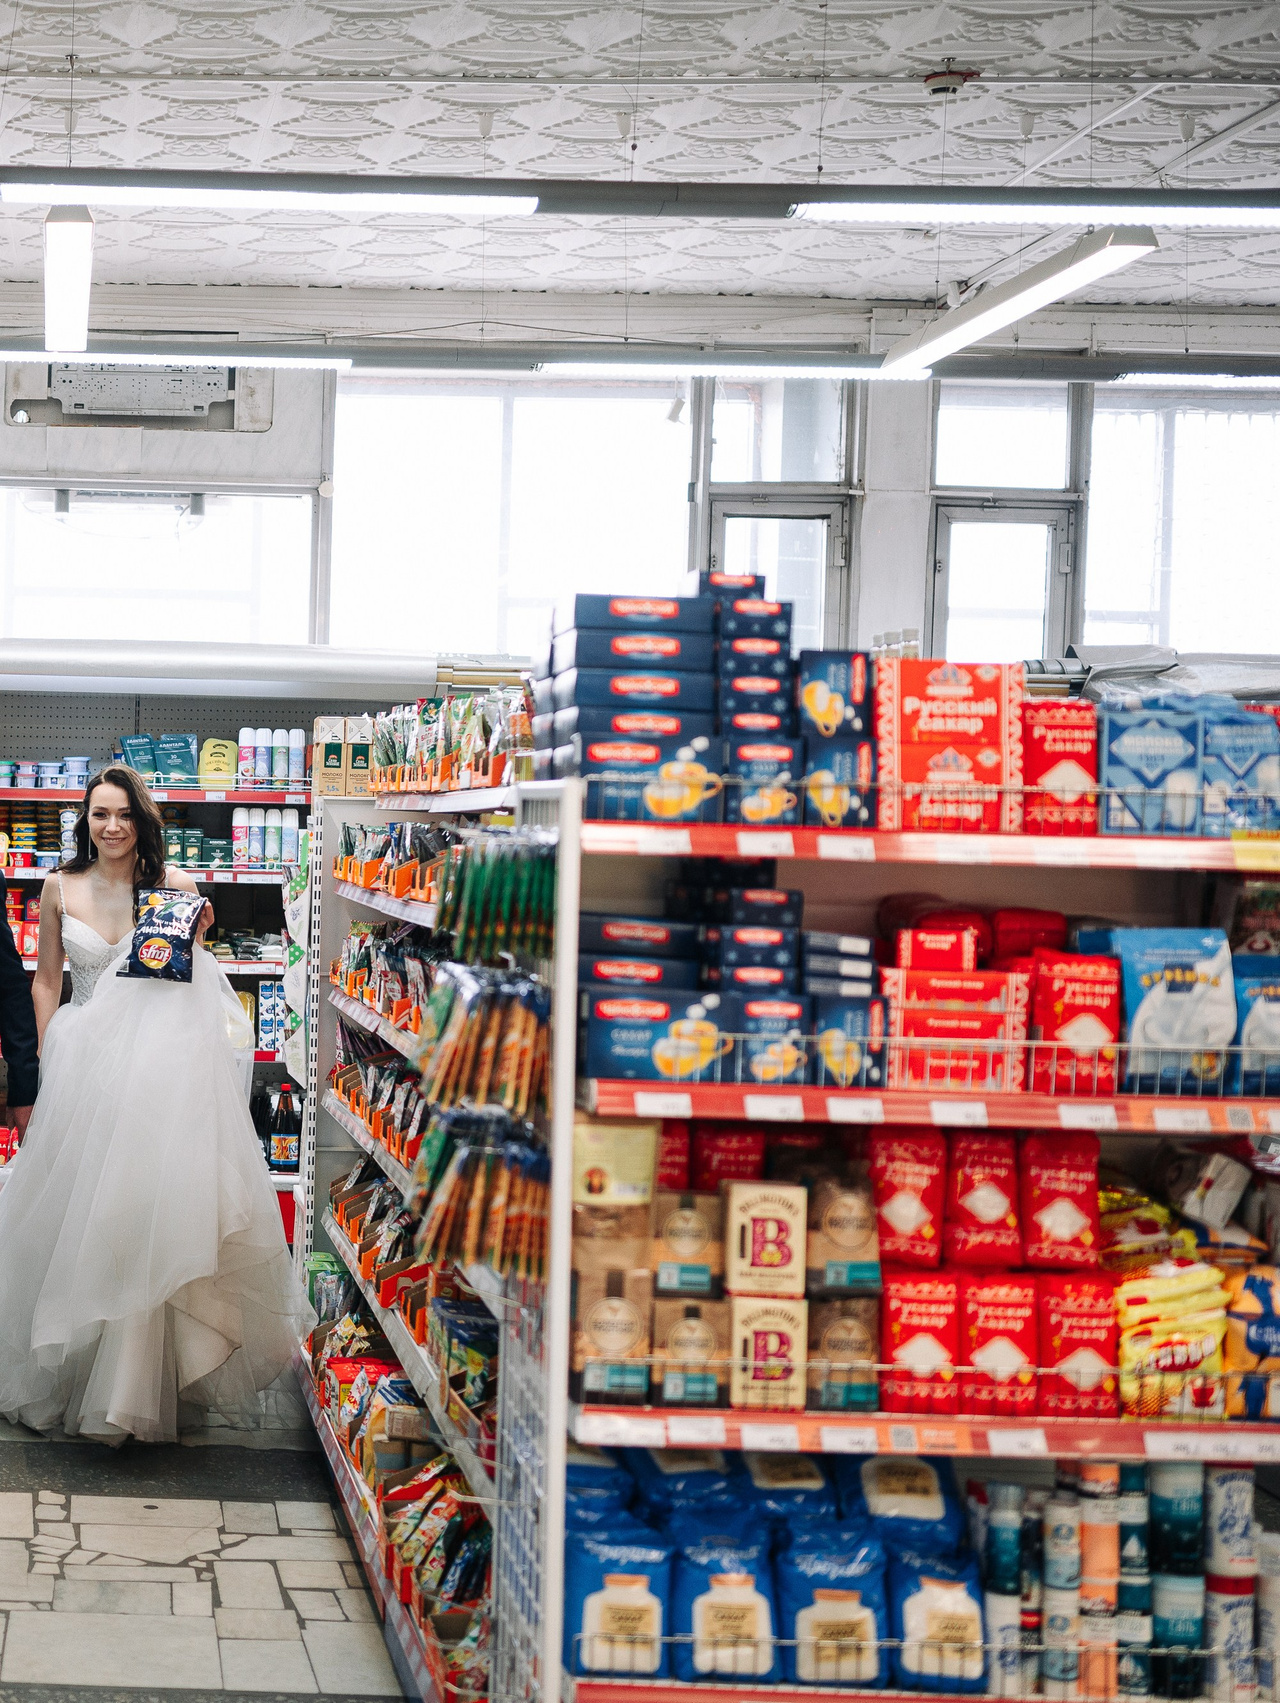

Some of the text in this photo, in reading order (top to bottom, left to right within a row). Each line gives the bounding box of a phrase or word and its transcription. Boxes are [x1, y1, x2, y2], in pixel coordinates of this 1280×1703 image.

[903, 695, 998, 720] Русский
[140, 945, 171, 962] Lay's
[750, 1217, 793, 1267] B
